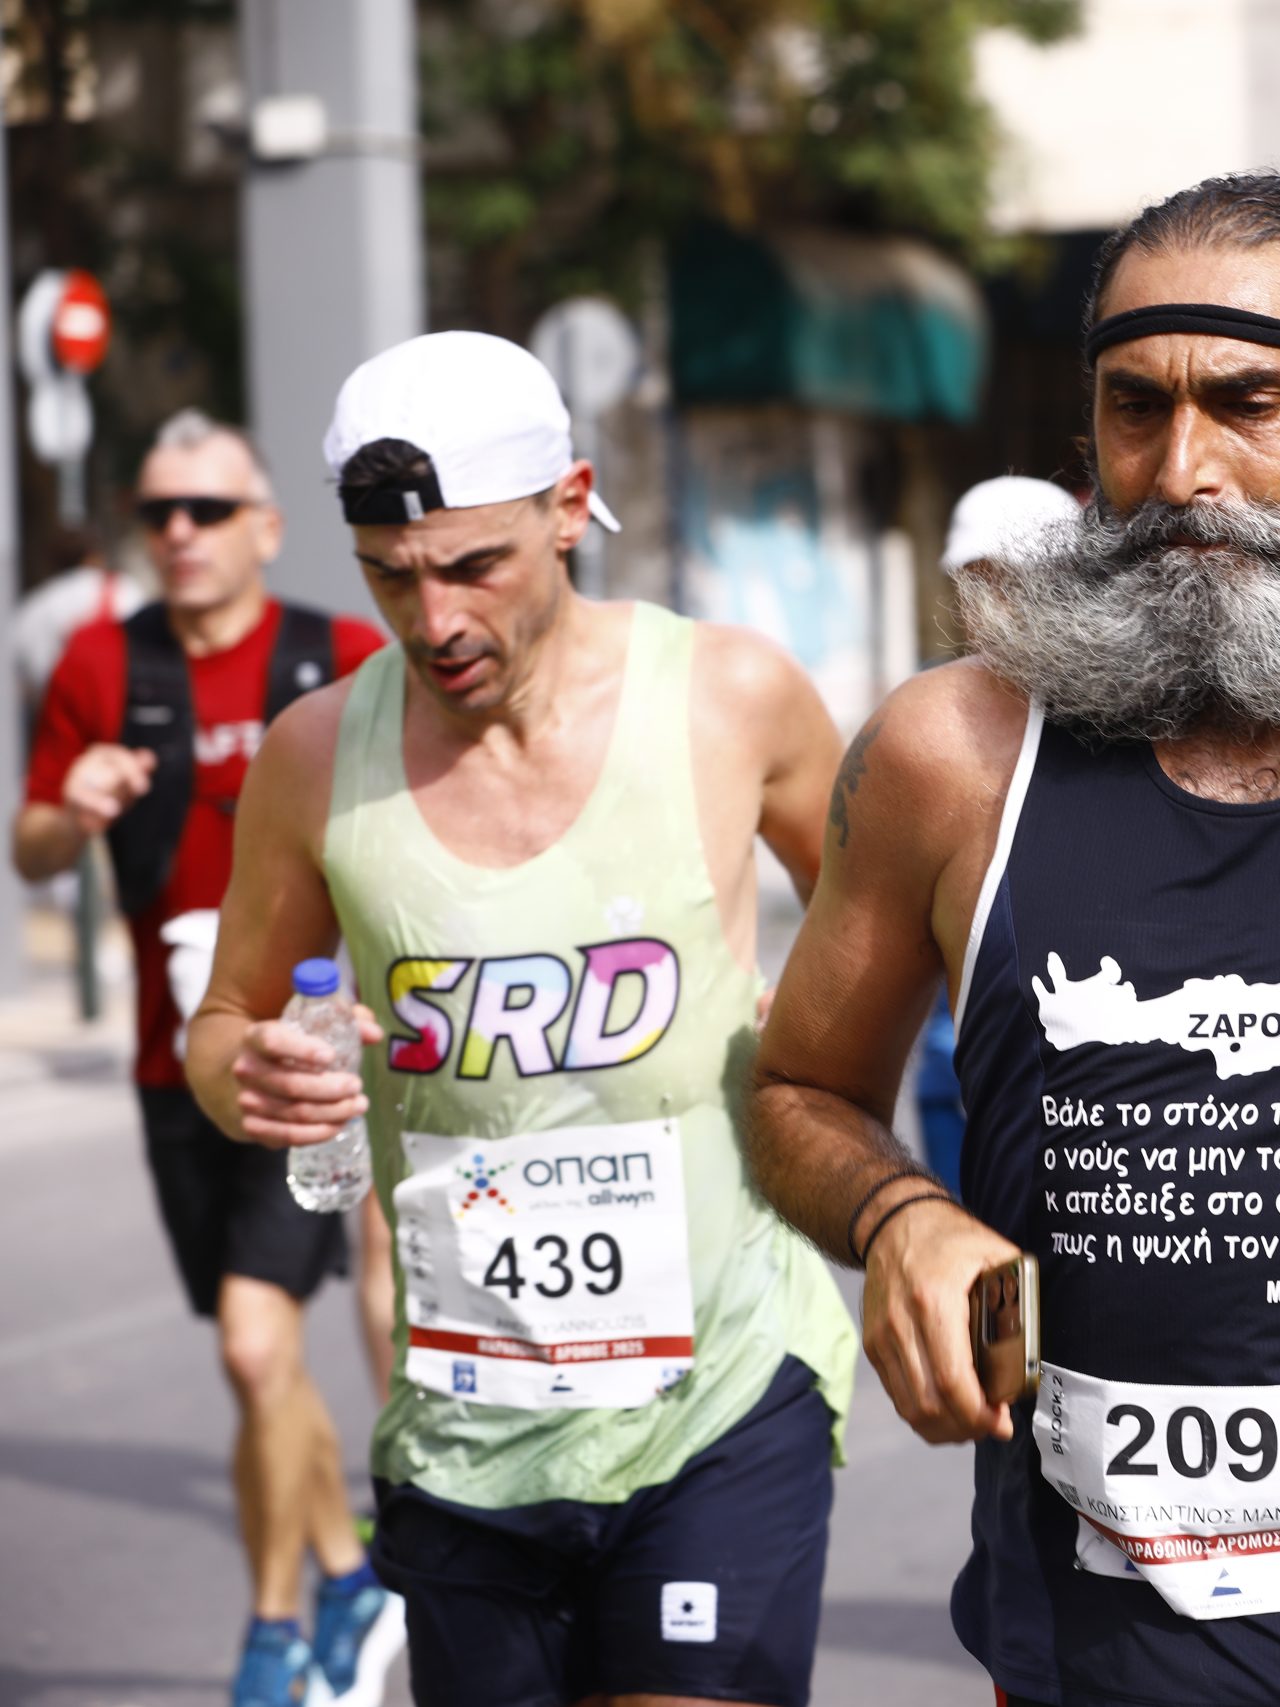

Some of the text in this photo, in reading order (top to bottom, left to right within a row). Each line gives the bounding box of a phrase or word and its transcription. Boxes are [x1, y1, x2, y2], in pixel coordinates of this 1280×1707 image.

[387, 936, 681, 1081] SRD
[1042, 1094, 1105, 1128] Βάλε
[1115, 1102, 1152, 1127] το
[1163, 1093, 1260, 1132] στόχο
[1044, 1147, 1057, 1171] ο
[1063, 1140, 1130, 1178] νούς
[1140, 1147, 1178, 1172] να
[1188, 1146, 1246, 1178] μην
[1065, 1181, 1195, 1223] απέδειξε
[1207, 1191, 1264, 1216] στο
[483, 1232, 623, 1299] 439
[1051, 1232, 1097, 1264] πως
[1106, 1234, 1123, 1264] η
[1132, 1226, 1213, 1265] ψυχή
[1223, 1235, 1280, 1260] τον
[1051, 1375, 1065, 1455] BLOCK 2
[1086, 1496, 1236, 1525] ΚΩΝΣΤΑΝΤΙΝΟΣ
